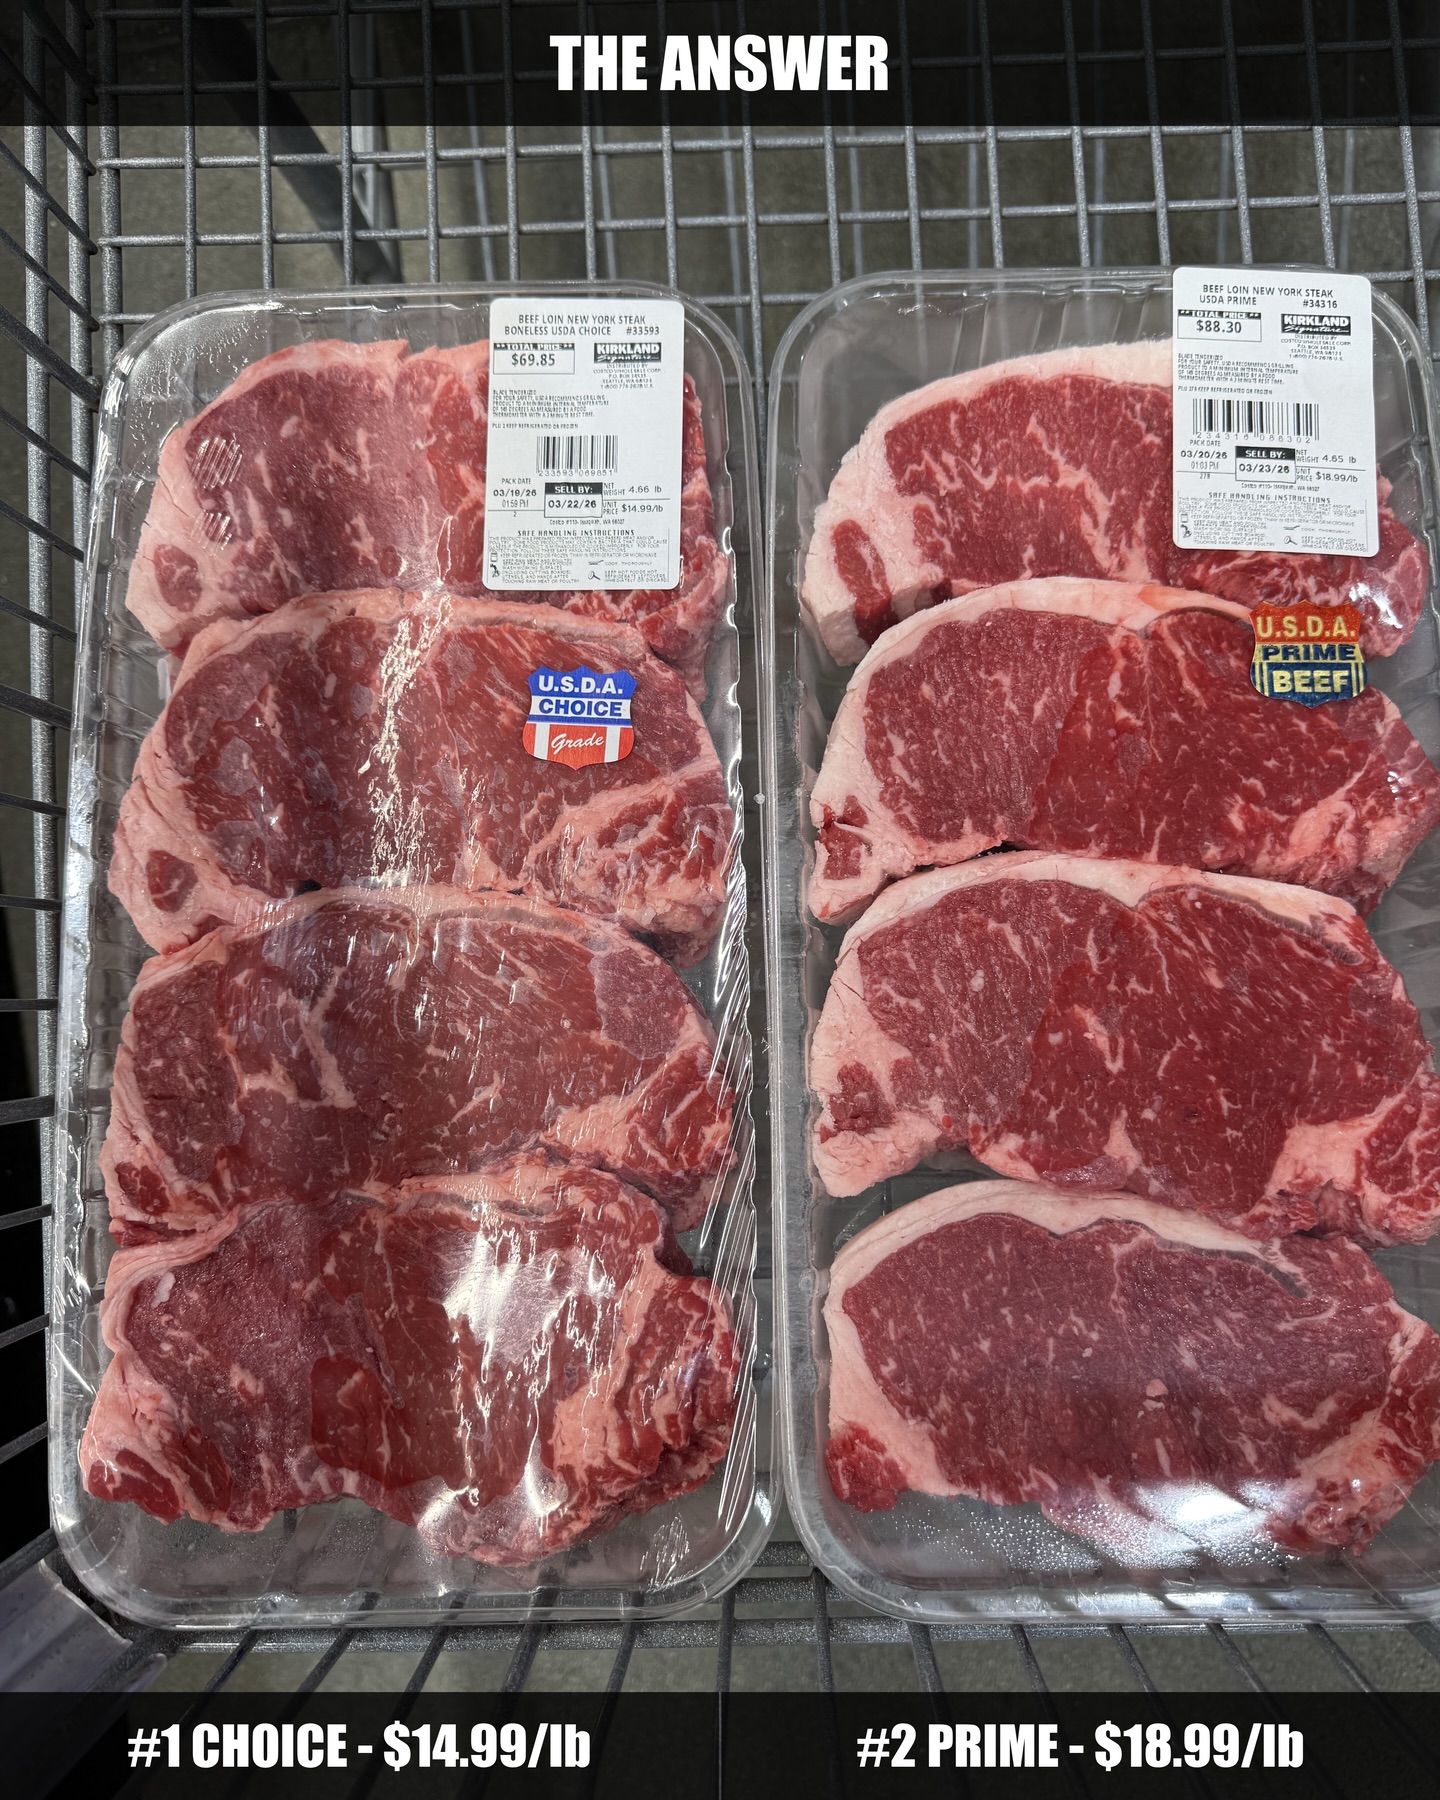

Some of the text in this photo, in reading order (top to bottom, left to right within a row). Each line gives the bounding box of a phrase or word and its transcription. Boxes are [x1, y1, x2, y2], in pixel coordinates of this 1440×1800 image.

[1203, 285, 1333, 298] BEEF LOIN NEW YORK STEAK
[1200, 295, 1257, 305] USDA PRIME
[1303, 300, 1338, 308] #34316
[519, 314, 646, 324] BEEF LOIN NEW YORK STEAK
[1284, 315, 1349, 327] KIRKLAND
[505, 326, 611, 336] BONELESS USDA CHOICE
[626, 326, 660, 335] #33593
[1196, 320, 1242, 333] $88.30
[597, 344, 660, 355] KIRKLAND
[512, 353, 555, 366] $69.85
[1180, 450, 1228, 459] 03/20/26
[1322, 455, 1344, 463] 4.65
[1209, 461, 1218, 470] PM
[1239, 463, 1290, 474] 03/23/26
[1316, 471, 1358, 482] $18.99/lb
[493, 489, 537, 497] 03/19/26
[554, 485, 593, 494] SELL BY:
[1274, 495, 1331, 503] INSTRUCTIONS
[548, 500, 597, 509] 03/22/26
[622, 504, 663, 513] $14.99/lb
[1256, 616, 1355, 638] U.S.D.A.
[1262, 644, 1356, 661] PRIME
[538, 675, 623, 694] U.S.D.A.
[1272, 670, 1348, 693] BEEF
[539, 698, 622, 717] CHOICE
[551, 732, 604, 755] Grade
